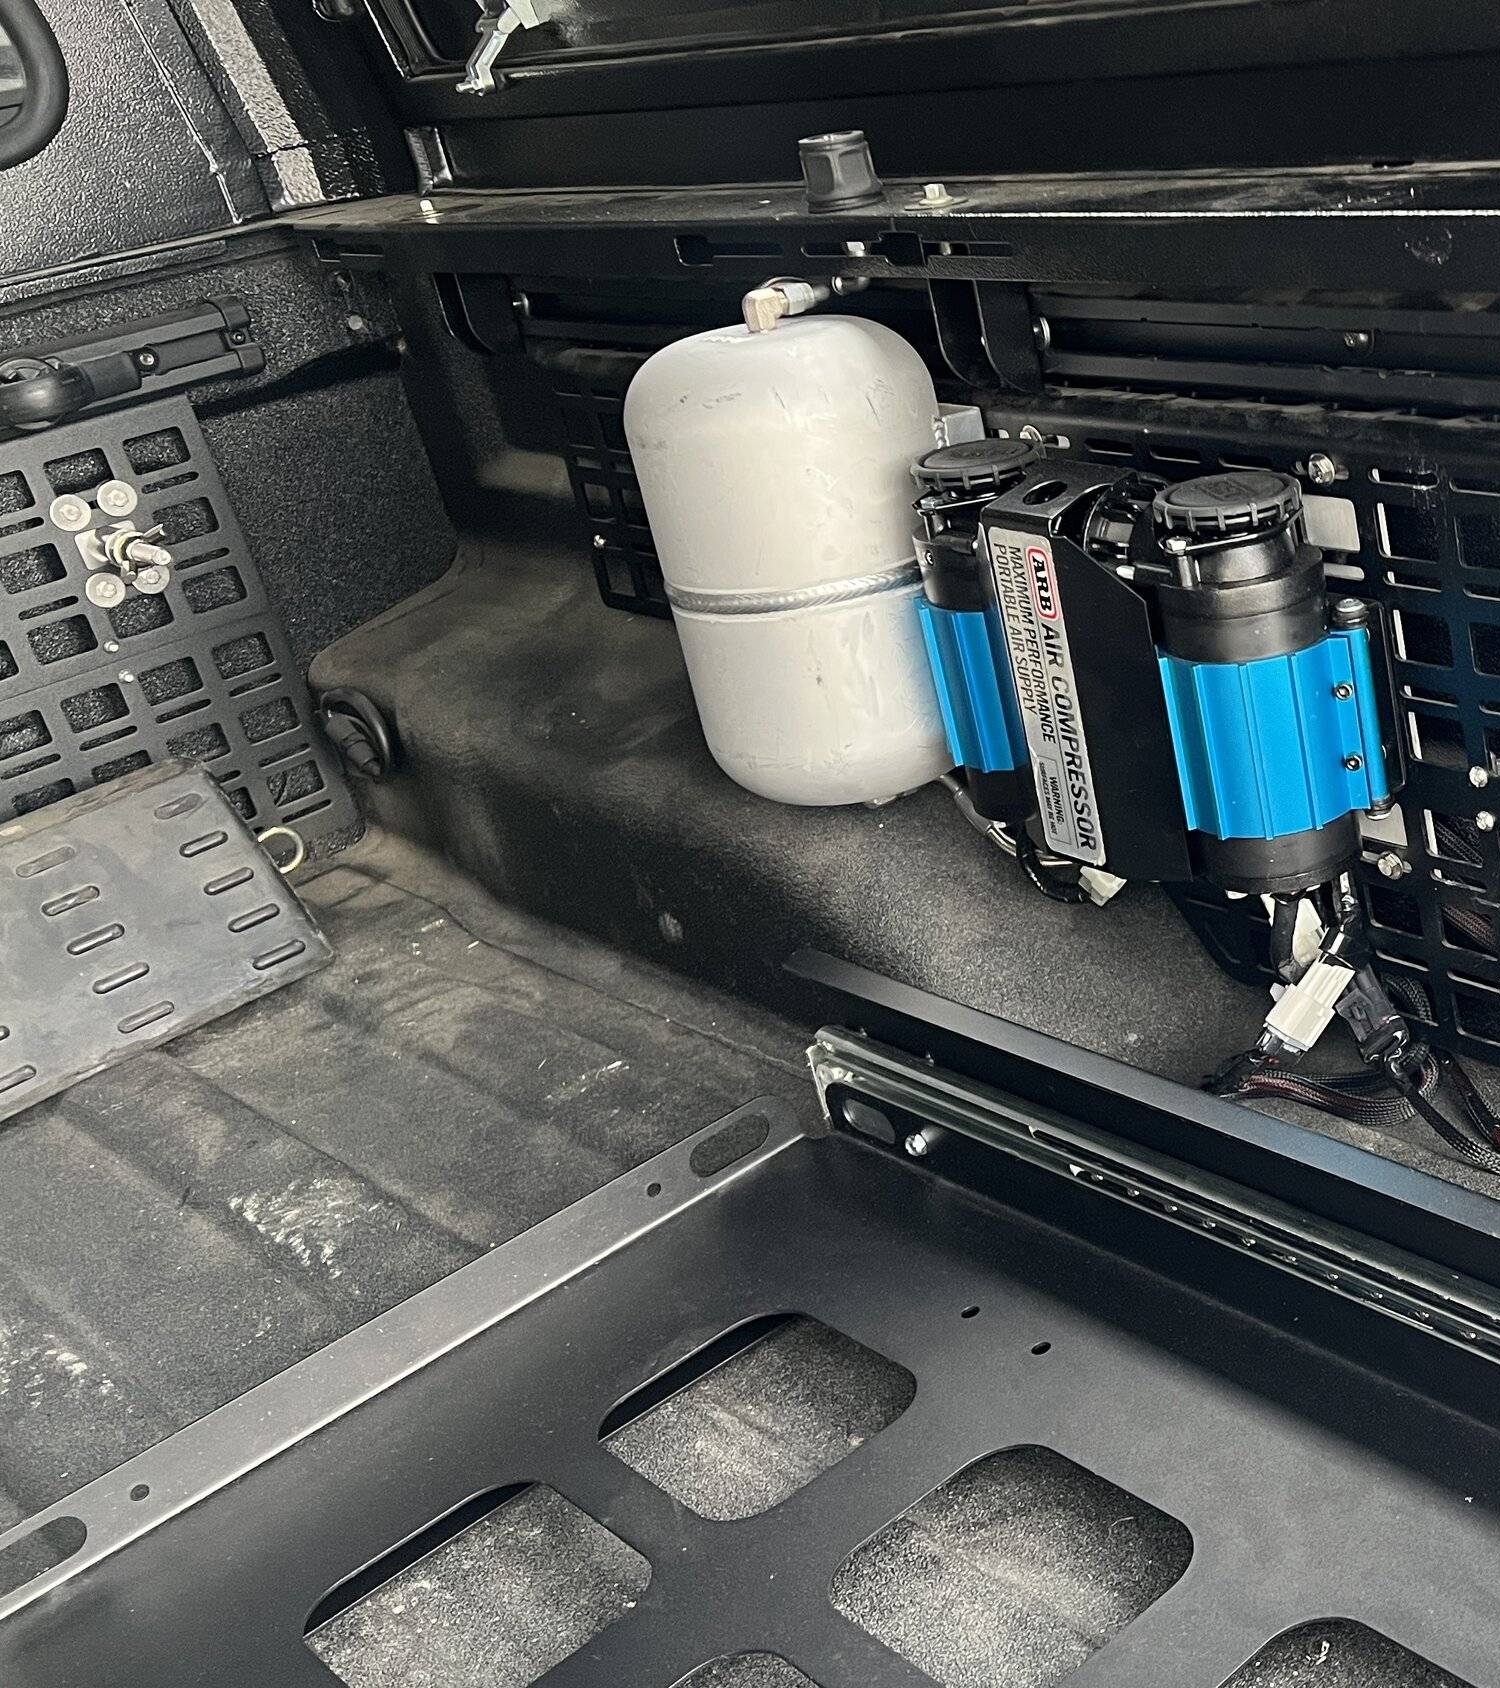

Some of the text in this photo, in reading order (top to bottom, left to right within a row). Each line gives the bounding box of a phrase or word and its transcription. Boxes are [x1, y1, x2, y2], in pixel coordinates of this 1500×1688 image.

[993, 543, 1037, 715] PORTABLE AIR SUPPLY
[1008, 546, 1056, 744] MAXIMUM PERFORMANCE
[1032, 557, 1053, 613] ARB
[1041, 622, 1097, 851] AIR COMPRESSOR
